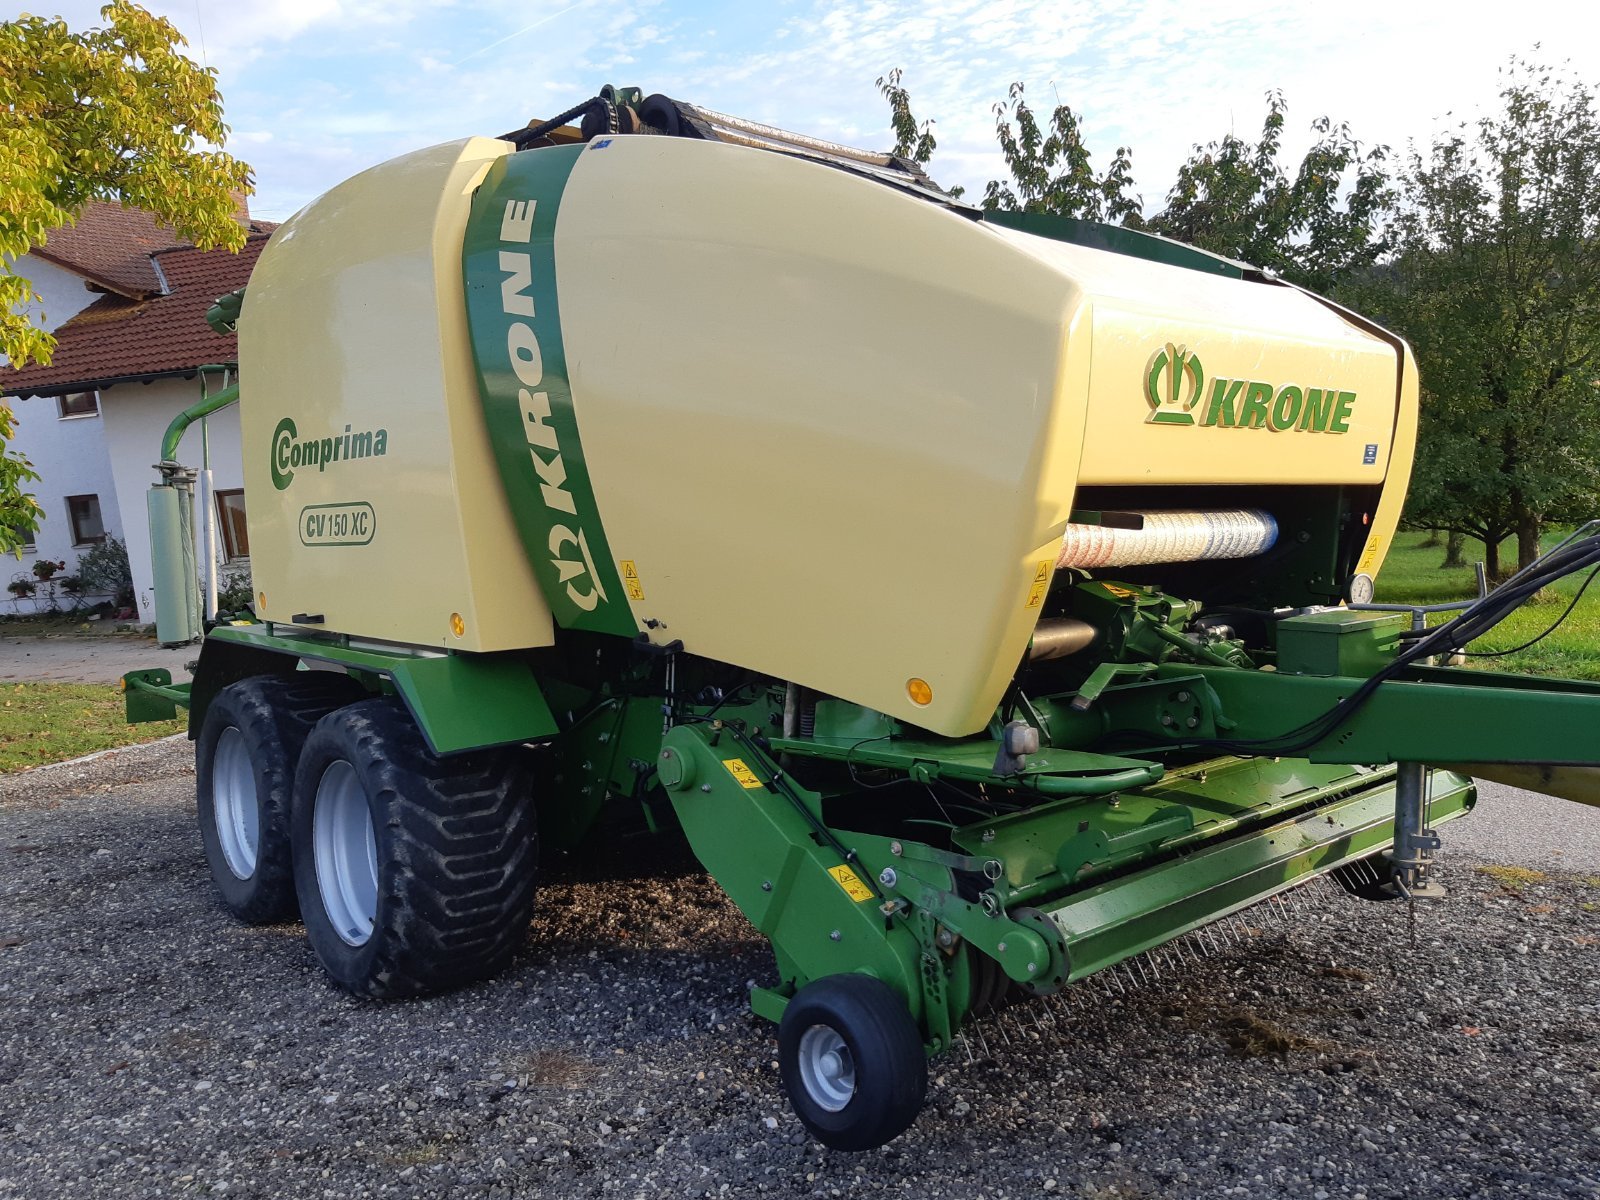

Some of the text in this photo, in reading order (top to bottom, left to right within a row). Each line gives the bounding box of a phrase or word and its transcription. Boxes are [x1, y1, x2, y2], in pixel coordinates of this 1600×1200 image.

[499, 198, 578, 515] KRONE
[1199, 377, 1357, 433] KRONE
[270, 417, 389, 491] Comprima
[306, 511, 368, 537] CV 150 XC
